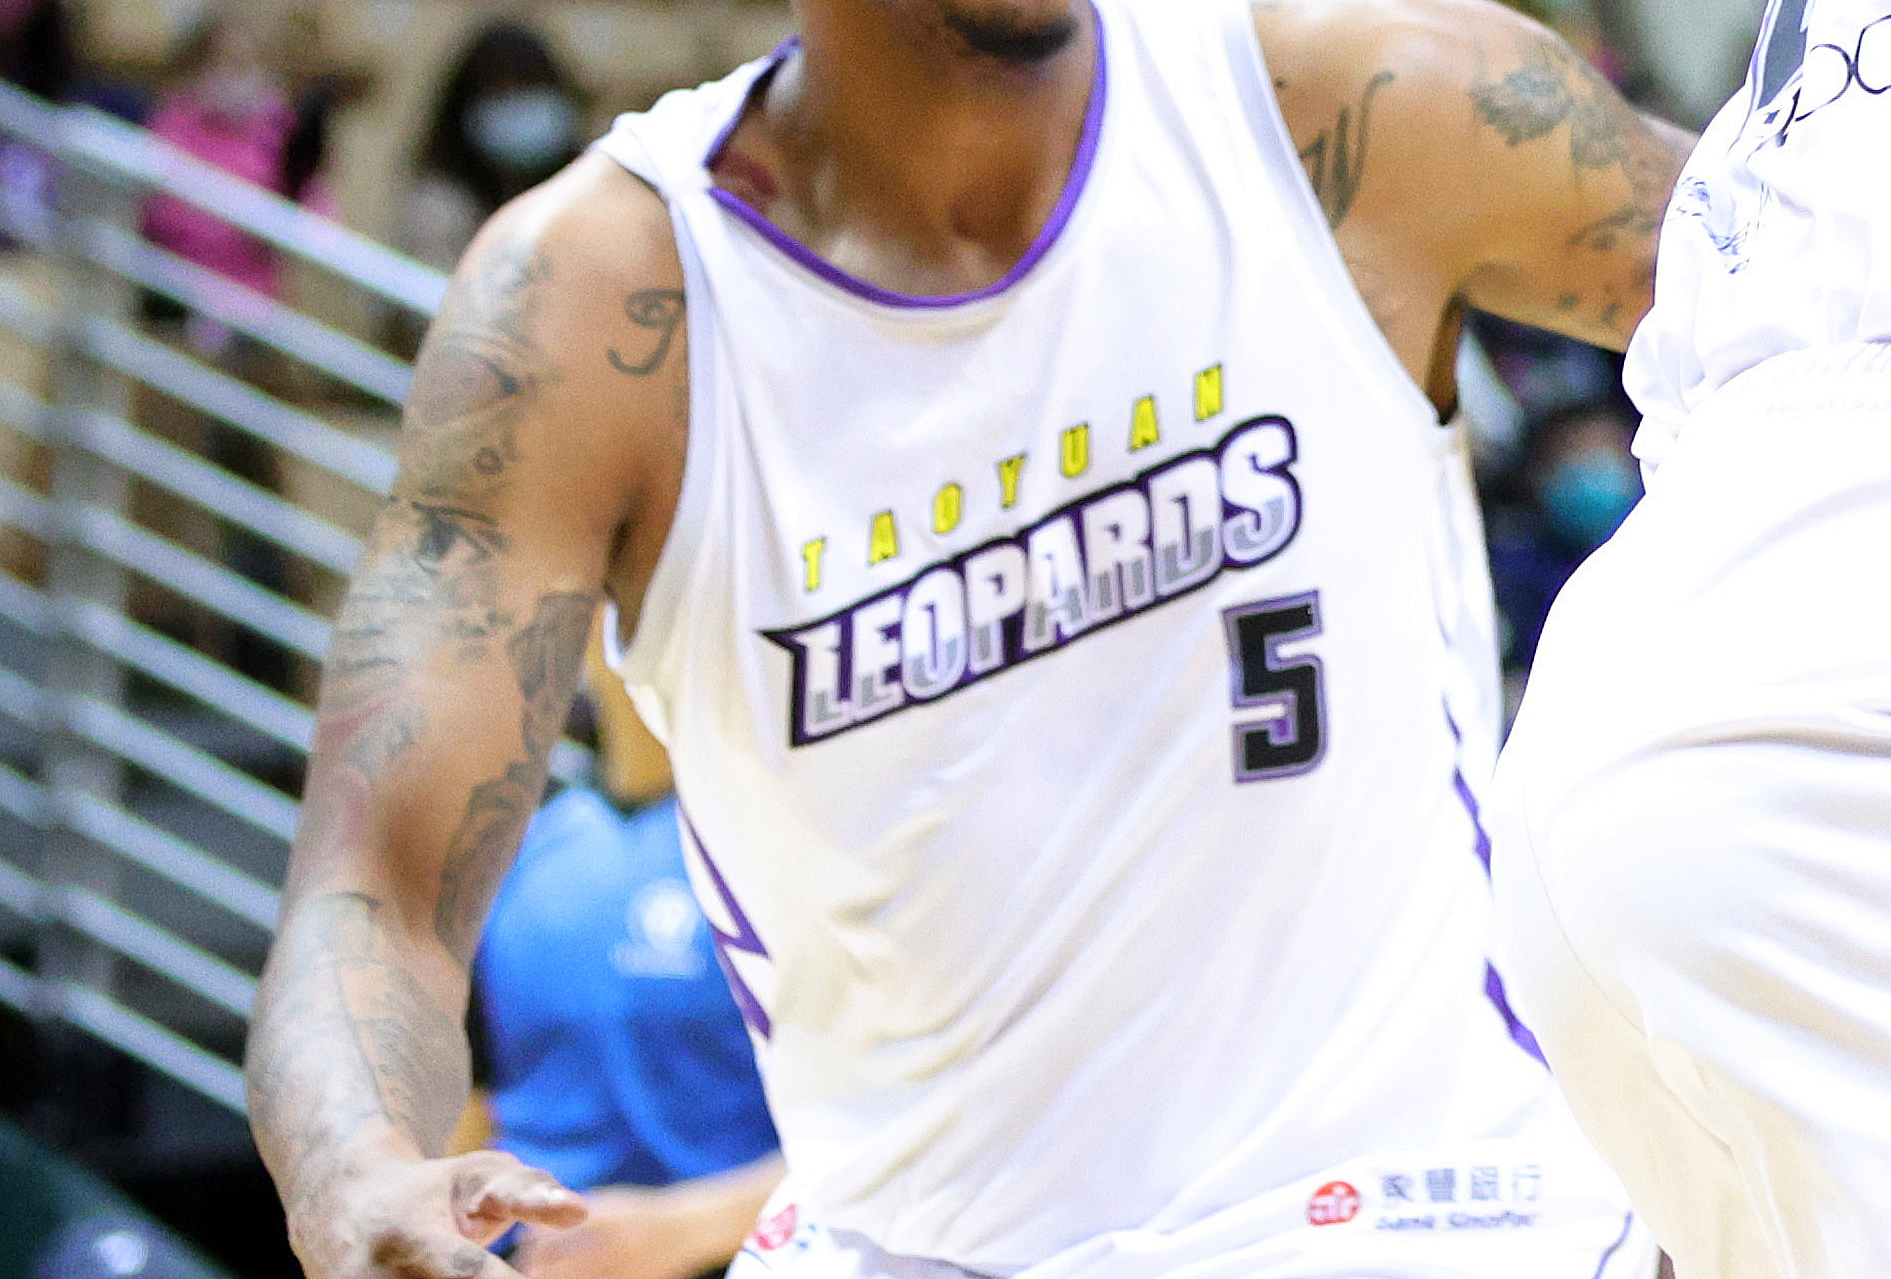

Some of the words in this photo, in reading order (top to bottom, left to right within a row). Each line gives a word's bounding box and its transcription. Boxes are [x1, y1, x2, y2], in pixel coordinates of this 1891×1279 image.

[758, 415, 1301, 747] LEOPARDS
[802, 362, 1223, 592] TAOYUAN
[1221, 588, 1329, 786] 5
